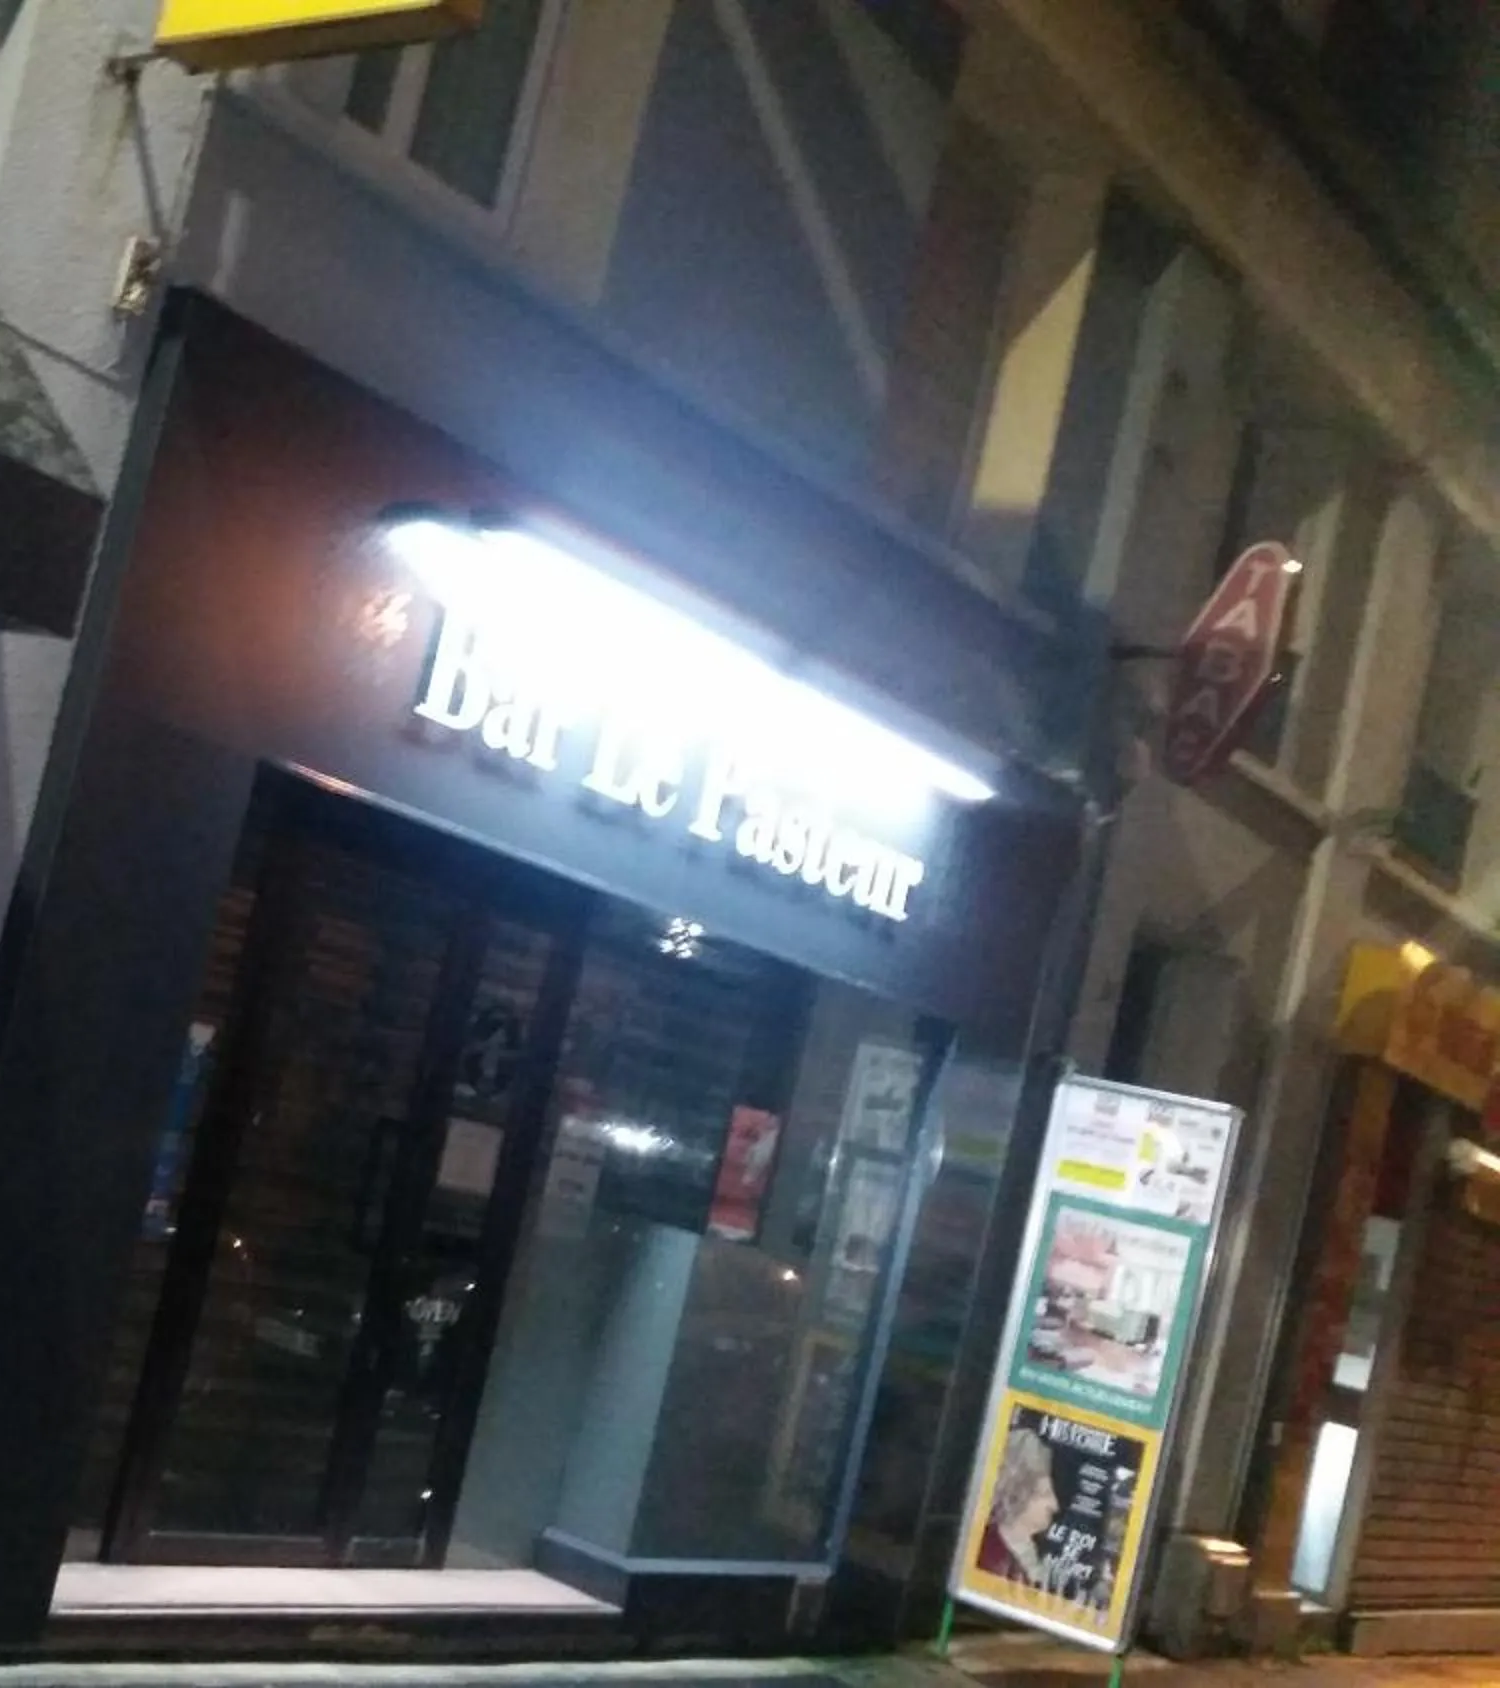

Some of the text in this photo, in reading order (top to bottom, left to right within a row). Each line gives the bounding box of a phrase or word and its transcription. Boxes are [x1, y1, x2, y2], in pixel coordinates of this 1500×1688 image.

[414, 600, 924, 922] Bar Le Pasteur
